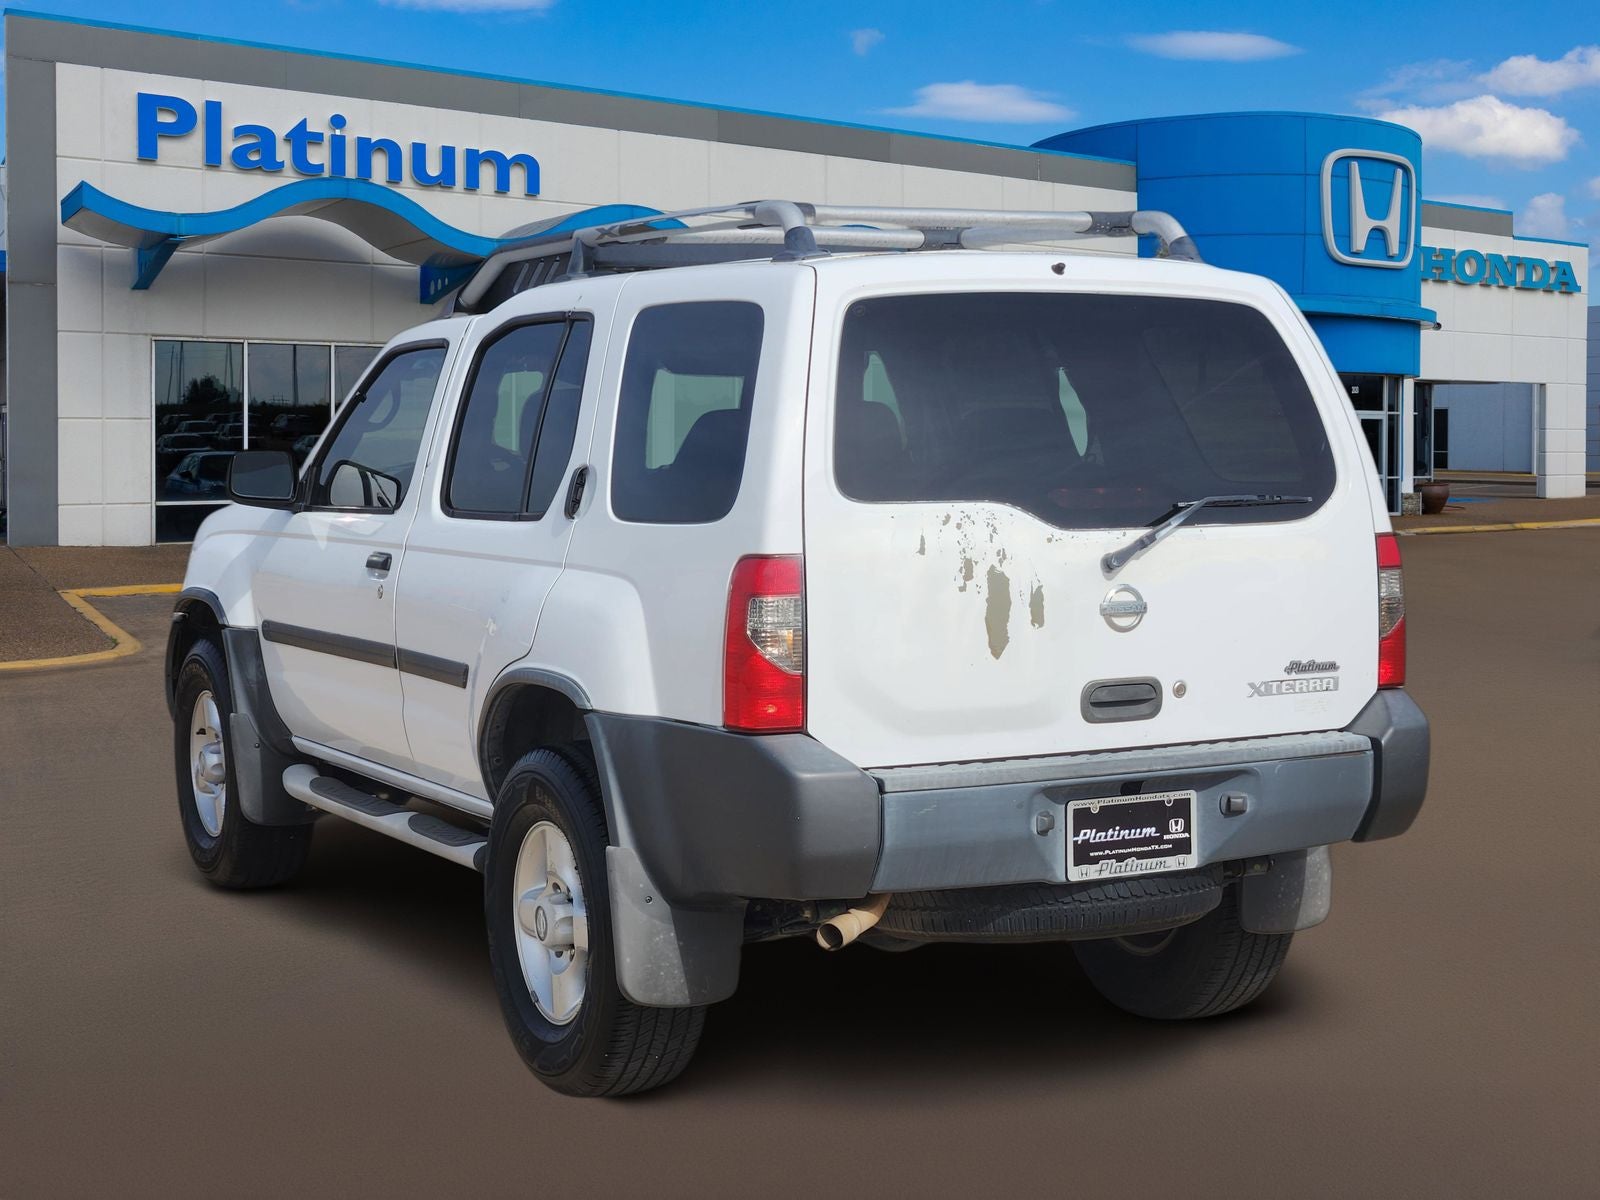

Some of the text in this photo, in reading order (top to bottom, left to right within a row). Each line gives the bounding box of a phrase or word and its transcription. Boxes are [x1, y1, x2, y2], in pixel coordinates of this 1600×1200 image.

[137, 92, 541, 196] Platinum
[1421, 246, 1581, 293] HONDA
[1284, 660, 1340, 675] Platinum
[1246, 677, 1336, 697] XTERRA
[1073, 826, 1160, 844] Platinum
[1094, 857, 1171, 876] Platinum
